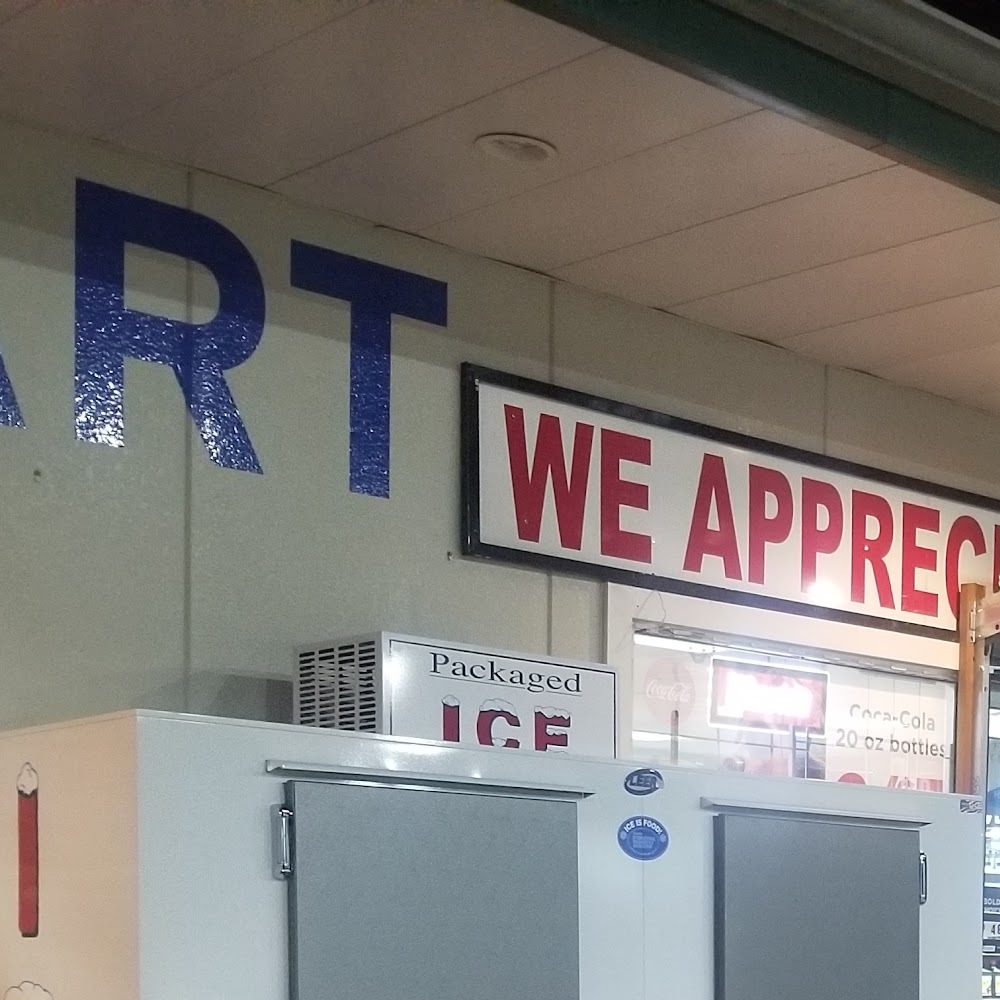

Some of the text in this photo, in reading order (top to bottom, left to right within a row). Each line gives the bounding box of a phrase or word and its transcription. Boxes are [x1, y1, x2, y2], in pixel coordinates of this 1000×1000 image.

[0, 178, 448, 499] RT
[504, 404, 652, 564] WE
[429, 652, 582, 694] Packaged
[441, 695, 572, 752] ICE
[835, 728, 946, 758] 20 oz bottles
[623, 818, 664, 835] ICE IS FOOD!
